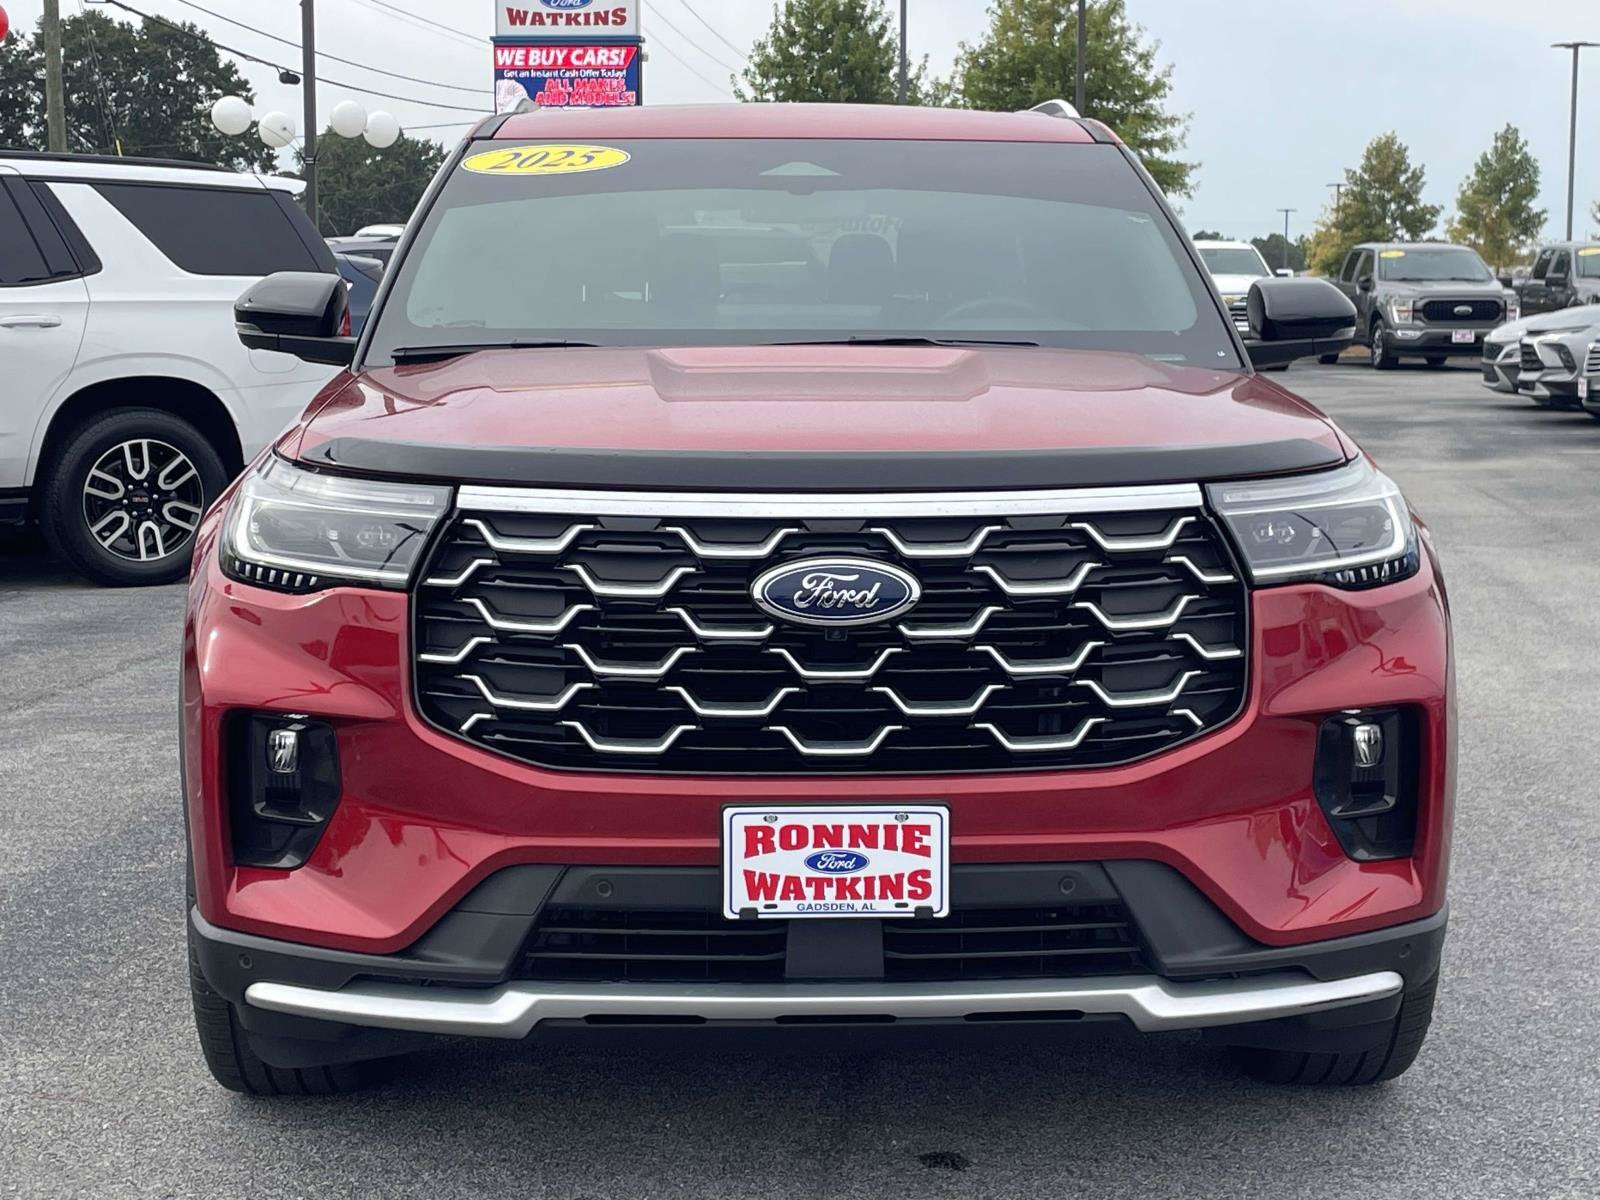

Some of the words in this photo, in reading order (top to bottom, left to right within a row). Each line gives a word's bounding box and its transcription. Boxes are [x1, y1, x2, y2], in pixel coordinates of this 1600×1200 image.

[506, 7, 627, 26] WATKINS
[496, 49, 526, 66] WE
[528, 49, 566, 66] BUY
[570, 49, 625, 66] CARS!
[545, 79, 572, 92] ALL
[573, 78, 626, 92] MAKES
[536, 91, 569, 105] AND
[569, 91, 635, 105] MODELS!
[486, 150, 605, 169] 2025
[793, 572, 882, 609] Ford
[743, 824, 932, 859] RONNIE
[816, 853, 857, 870] Ford
[742, 869, 933, 901] WATKINS
[796, 903, 858, 914] GADSDEN,
[861, 903, 876, 912] AL
